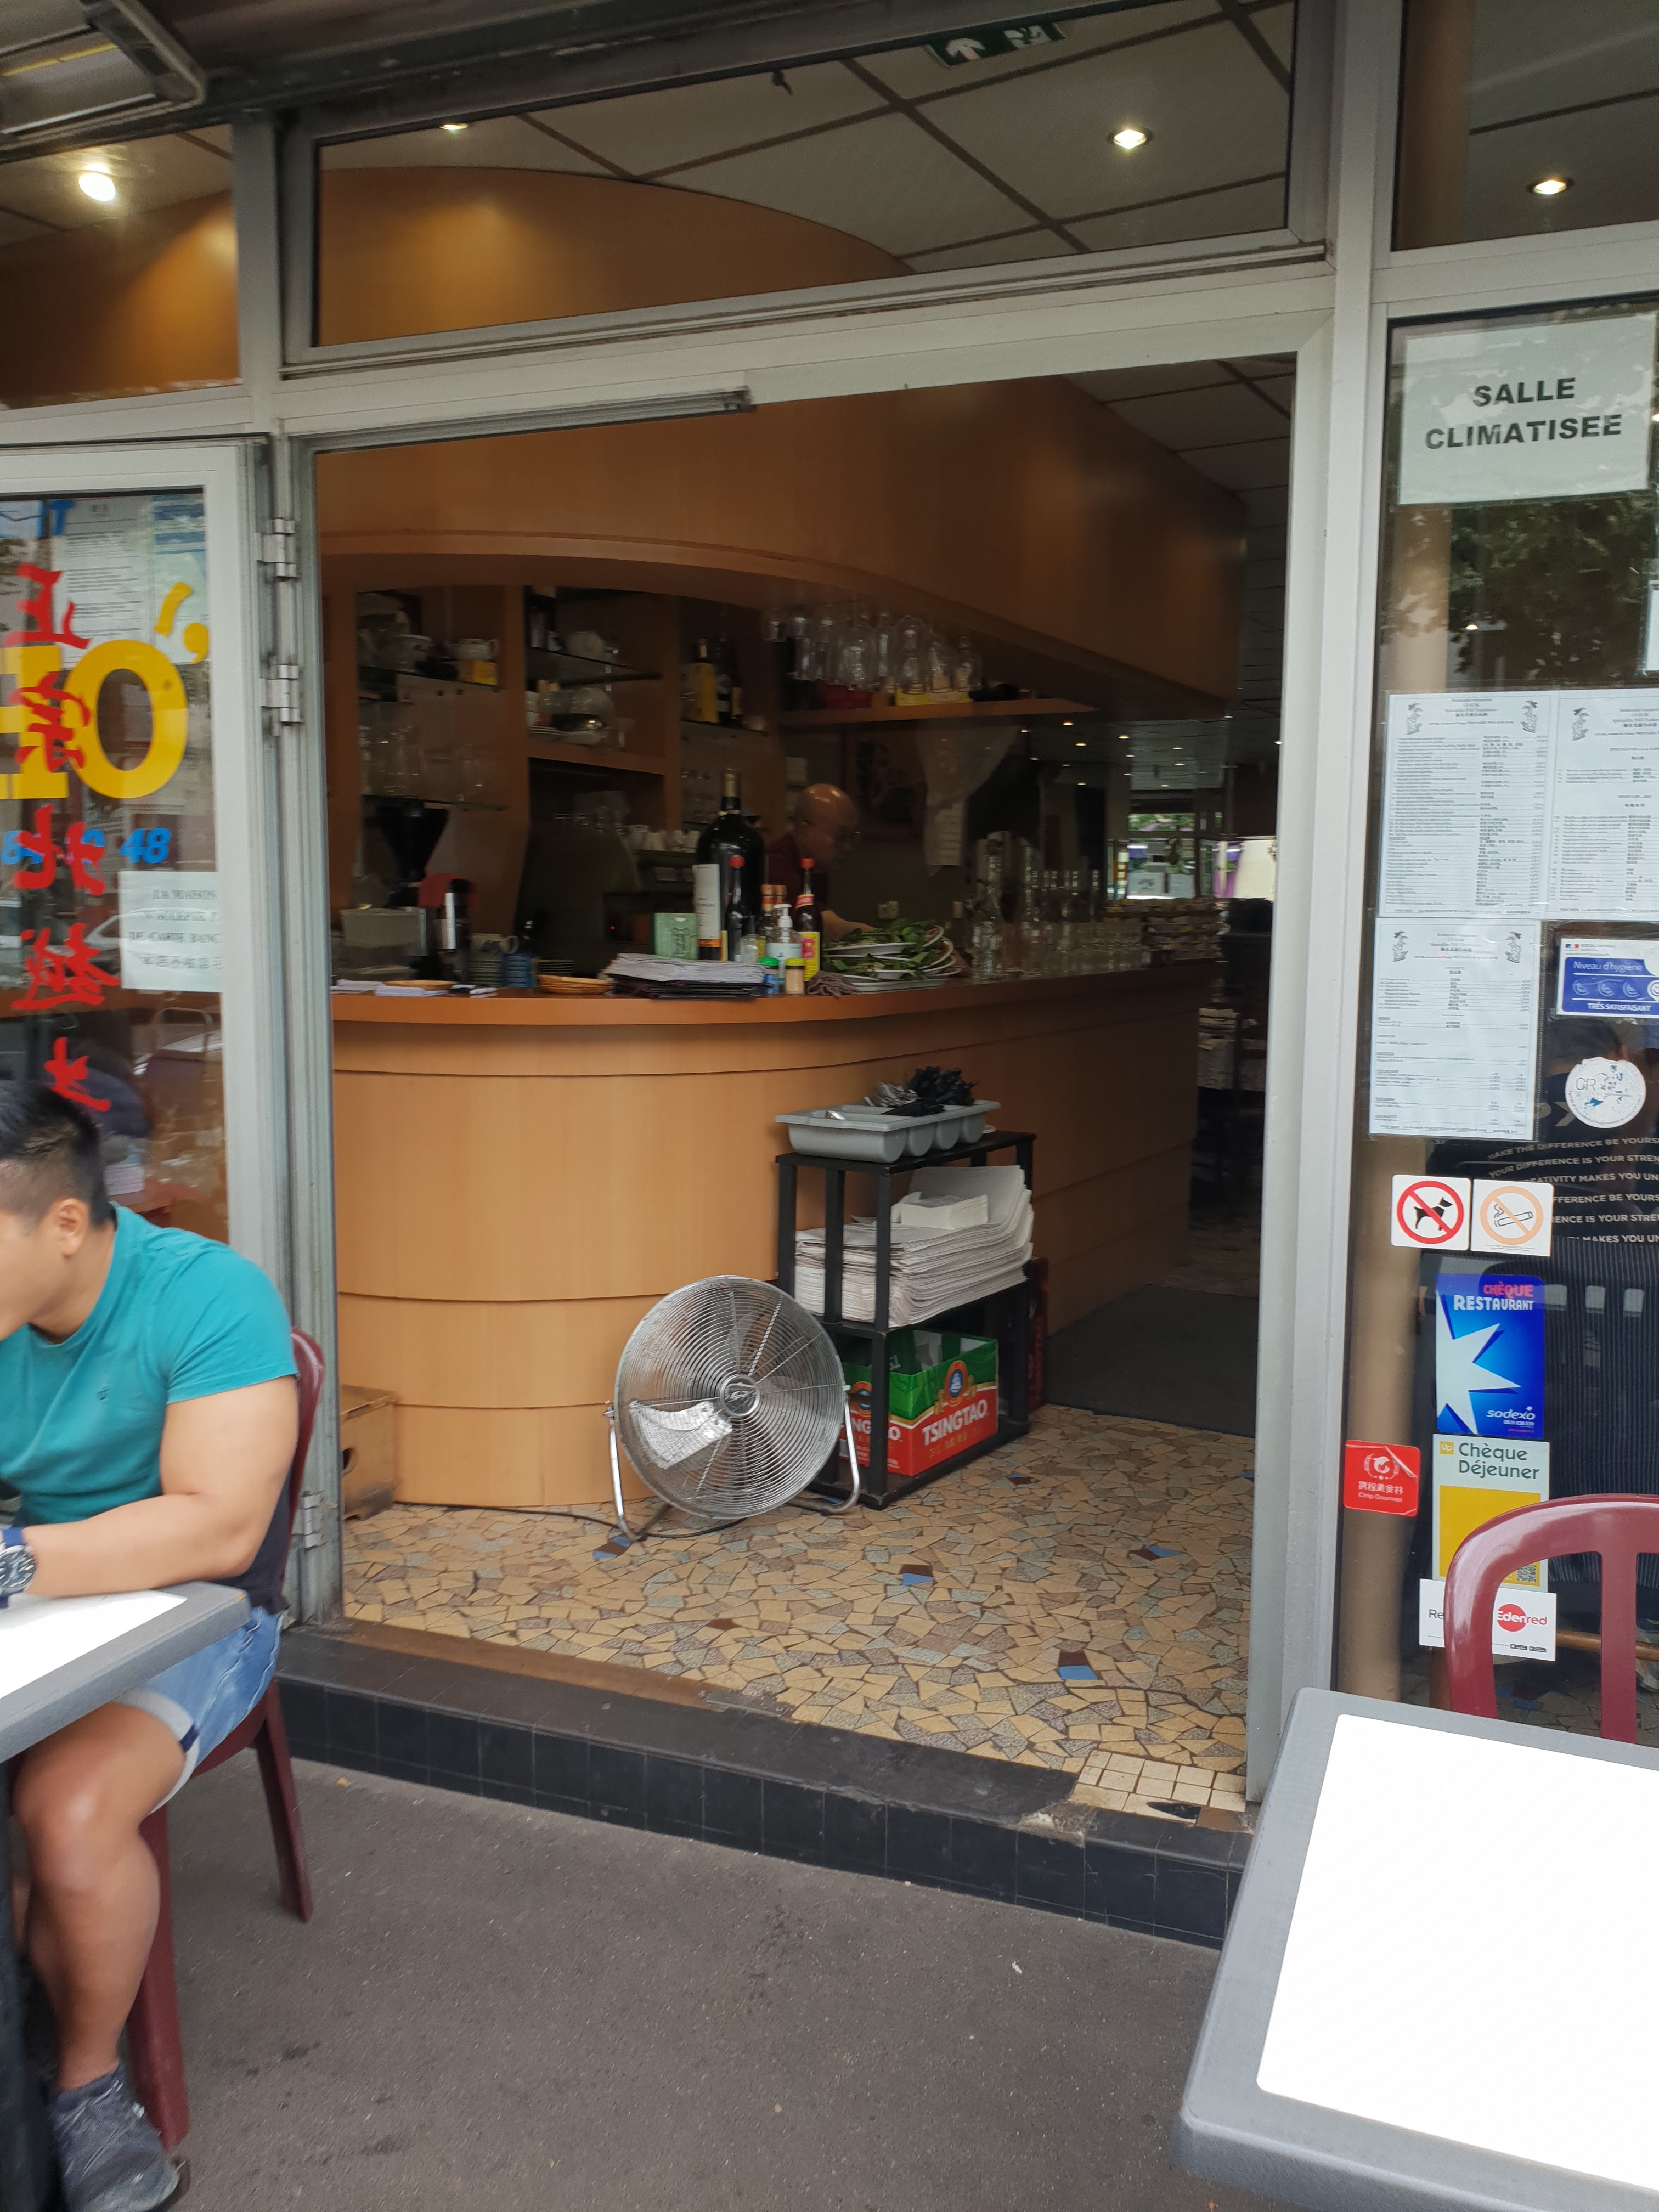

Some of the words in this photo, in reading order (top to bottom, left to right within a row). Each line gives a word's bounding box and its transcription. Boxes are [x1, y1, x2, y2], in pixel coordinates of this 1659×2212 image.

[1473, 377, 1576, 407] SALLE
[1425, 414, 1622, 449] CLIMATISEE
[119, 827, 172, 864] 48
[1573, 961, 1601, 970] Niveau
[1537, 1140, 1602, 1150] DIFFERENCE
[1516, 1158, 1580, 1170] DIFFERENCE
[1579, 1173, 1616, 1182] MAKES
[1585, 1215, 1596, 1223] IS
[1598, 1214, 1628, 1222] YOUR
[1630, 1214, 1659, 1222] STRE
[1621, 1235, 1645, 1243] YOU
[1483, 1280, 1534, 1299] CHÈQUE
[1454, 1294, 1534, 1311] RESTAURANT
[922, 1398, 988, 1446] TSINGTAO
[1486, 1408, 1536, 1420] sodexo
[1459, 1442, 1528, 1463] Chèque
[1459, 1460, 1540, 1480] Déjeuner
[1497, 1610, 1548, 1626] Edenred
